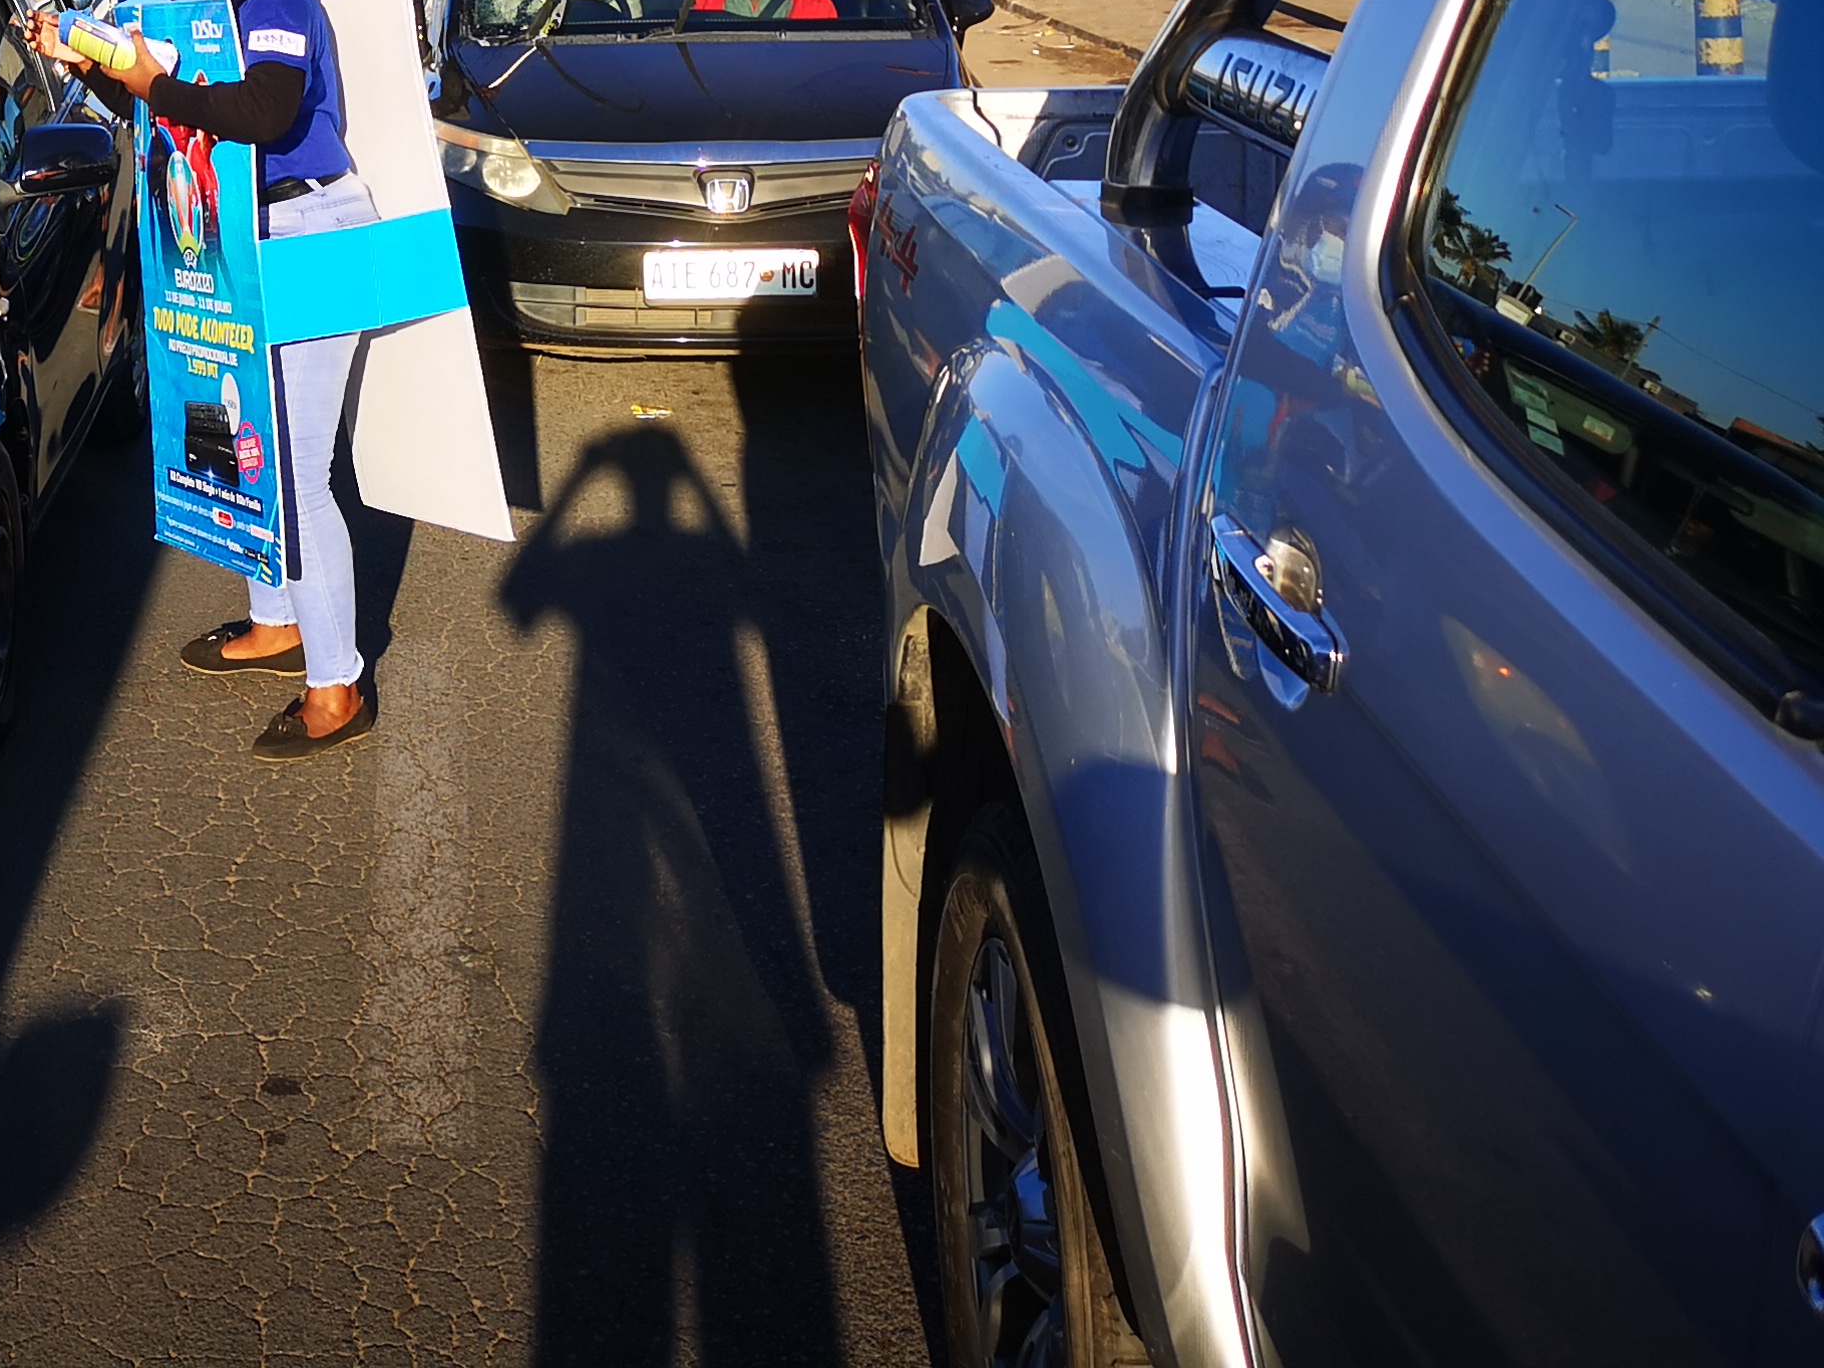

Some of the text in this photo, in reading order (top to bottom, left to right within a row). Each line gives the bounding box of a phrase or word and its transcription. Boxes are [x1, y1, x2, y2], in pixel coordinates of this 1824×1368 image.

[651, 260, 814, 289] AIE 687 MC
[153, 306, 255, 354] TUDO PODE ACONTECER
